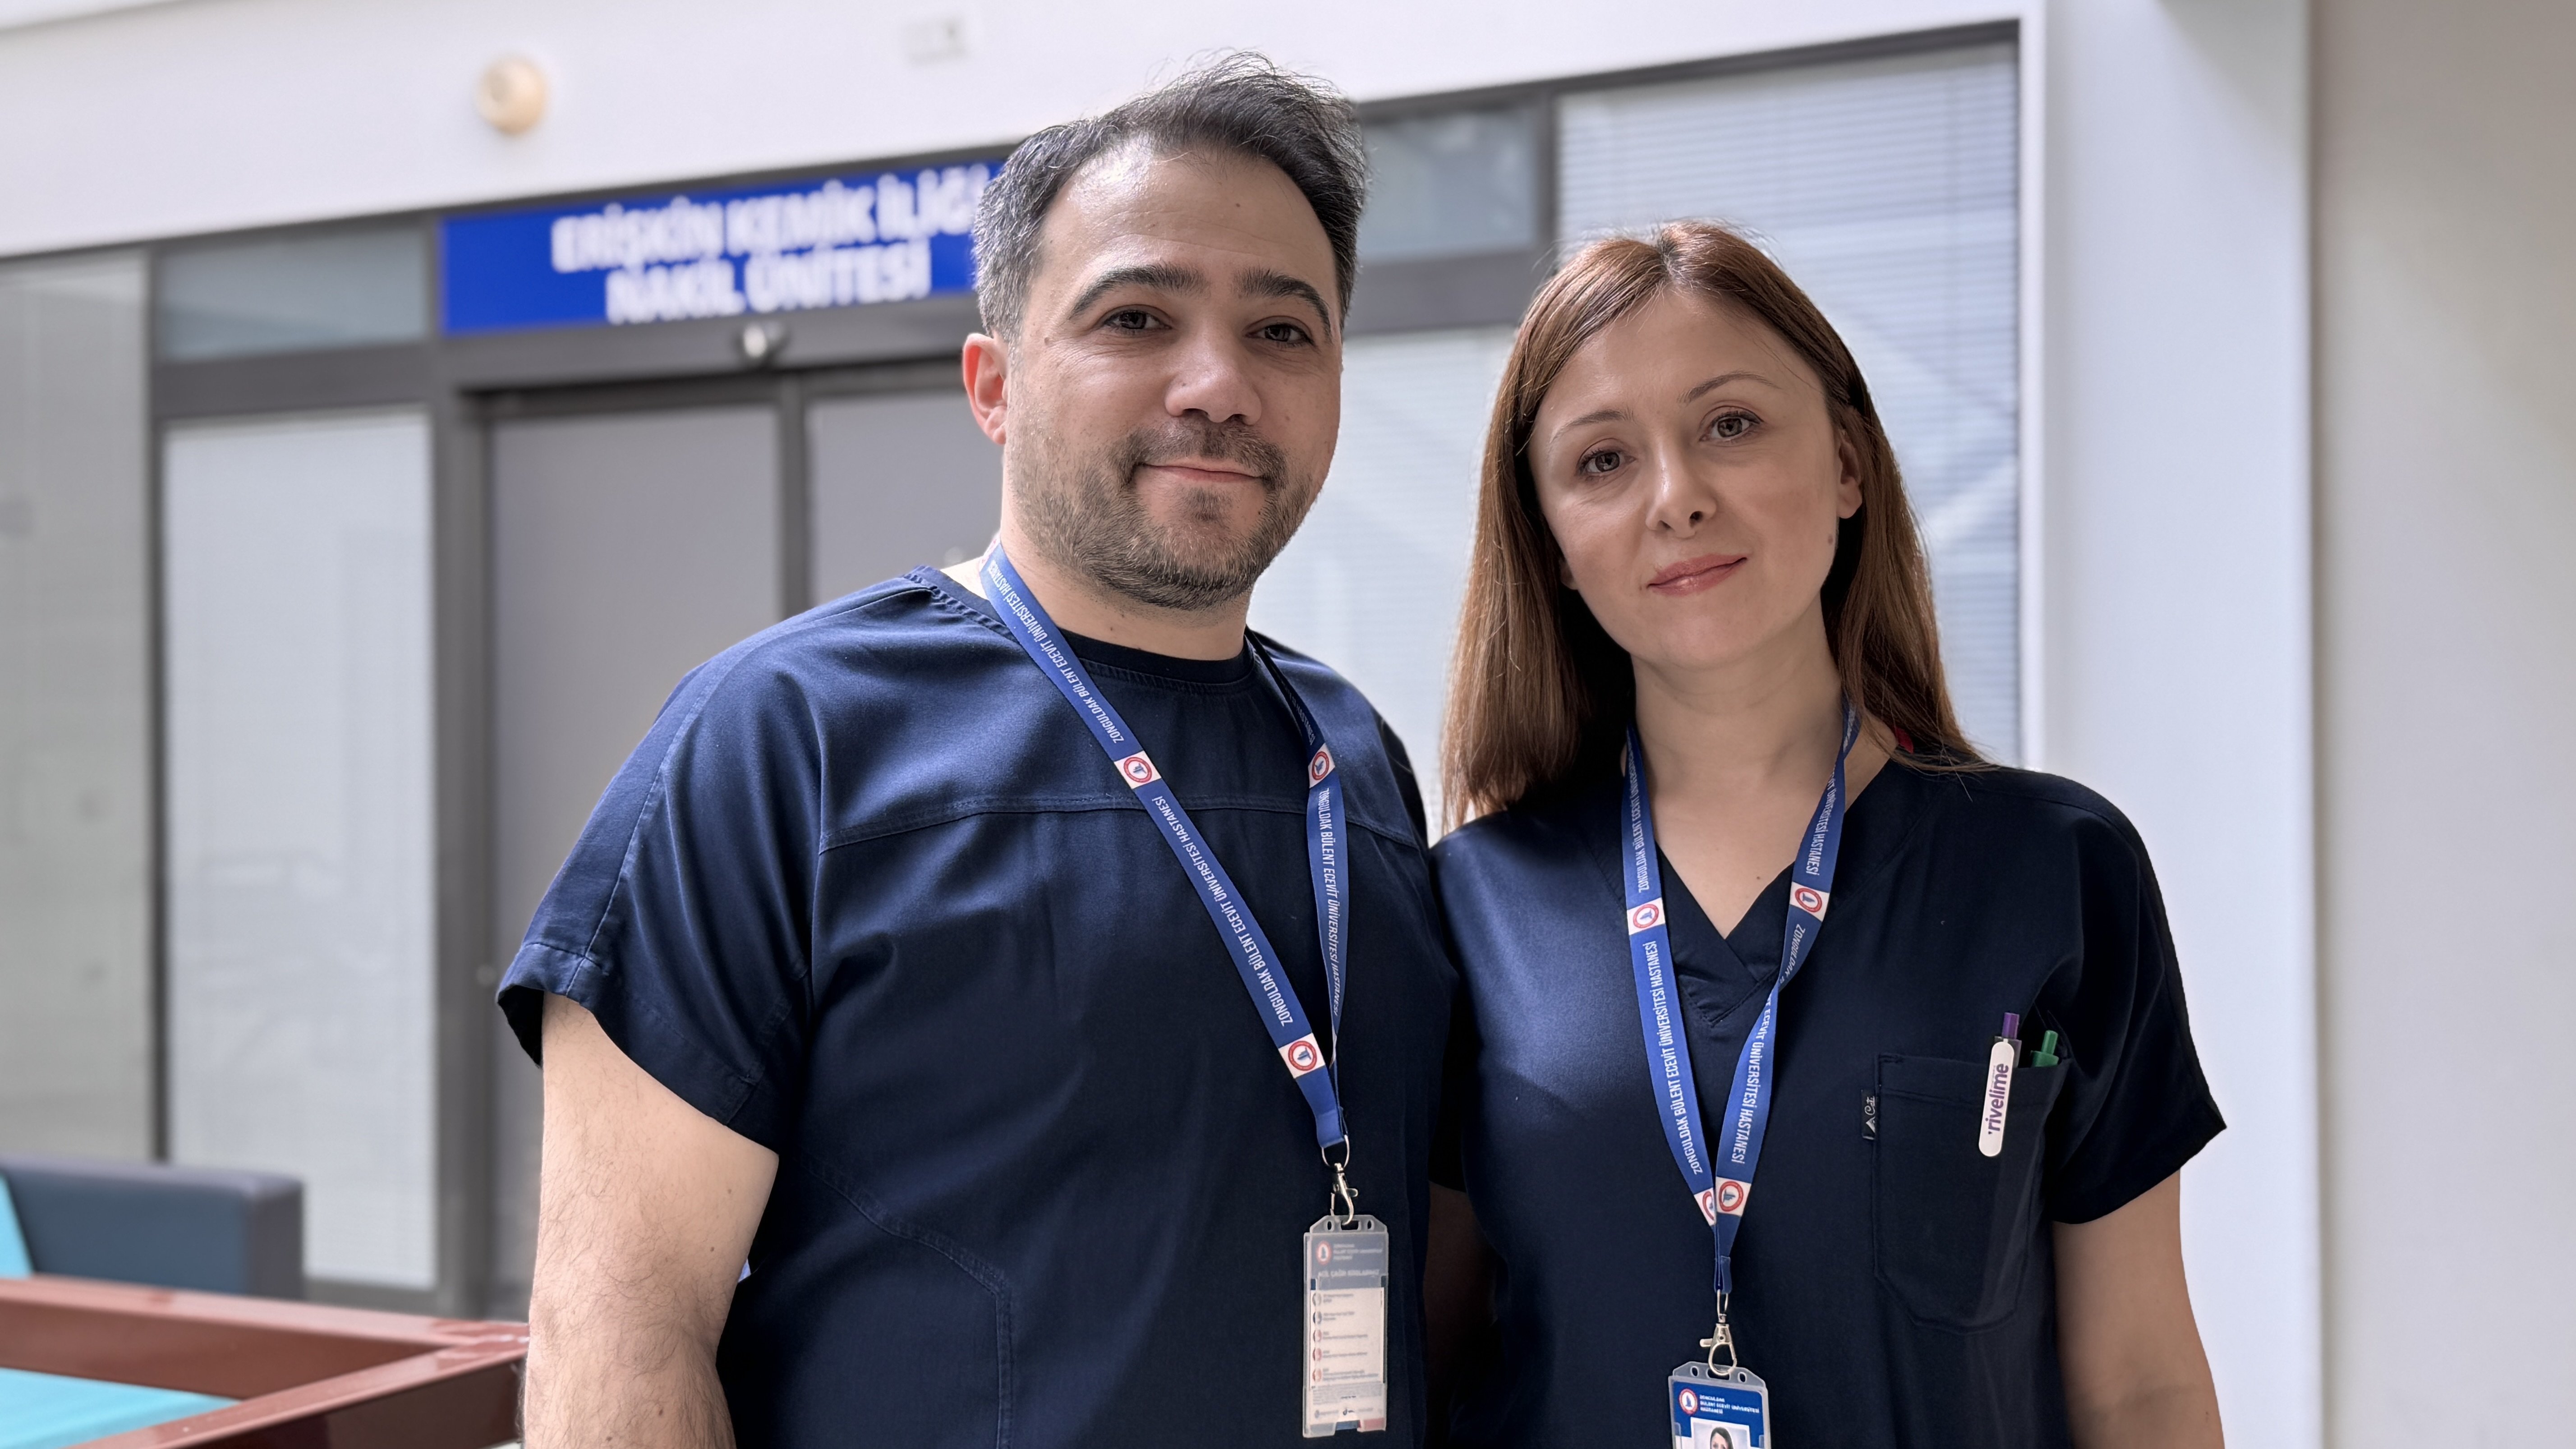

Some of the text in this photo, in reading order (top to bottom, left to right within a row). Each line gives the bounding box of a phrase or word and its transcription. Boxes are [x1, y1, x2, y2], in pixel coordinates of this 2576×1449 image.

[551, 195, 722, 273] ERİŞKİN
[725, 179, 876, 257] KEMİK
[606, 237, 932, 325] NAKİL ÜNİTESİ
[1002, 590, 1048, 642] ÜNİVERSİTESİ
[1040, 639, 1067, 668] ECEVİT
[1060, 667, 1090, 697] BÜLENT
[1083, 697, 1124, 744] ZONGULDAK
[1320, 831, 1336, 866] BÜLENT
[1632, 820, 1645, 850] BÜLENT
[1805, 833, 1825, 875] HASTANESİ
[1323, 867, 1339, 898] ECEVİT
[1635, 848, 1650, 893] ZONGULDAK
[1151, 796, 1293, 1026] ZONGULDAK BÜLENT ECEVİT ÜNİVERSİTESİ HASTANESİ
[1327, 897, 1340, 962] ÜNİVERSİTESİ
[1785, 923, 1806, 976] ZONGULDAK
[1642, 940, 1703, 1175] ZONGULDAK BÜLENT ECEVİT ÜNİVERSİTESİ HASTANESİ
[1731, 1008, 1771, 1164] ECEVİT ÜNİVERSİTESİ HASTANESİ
